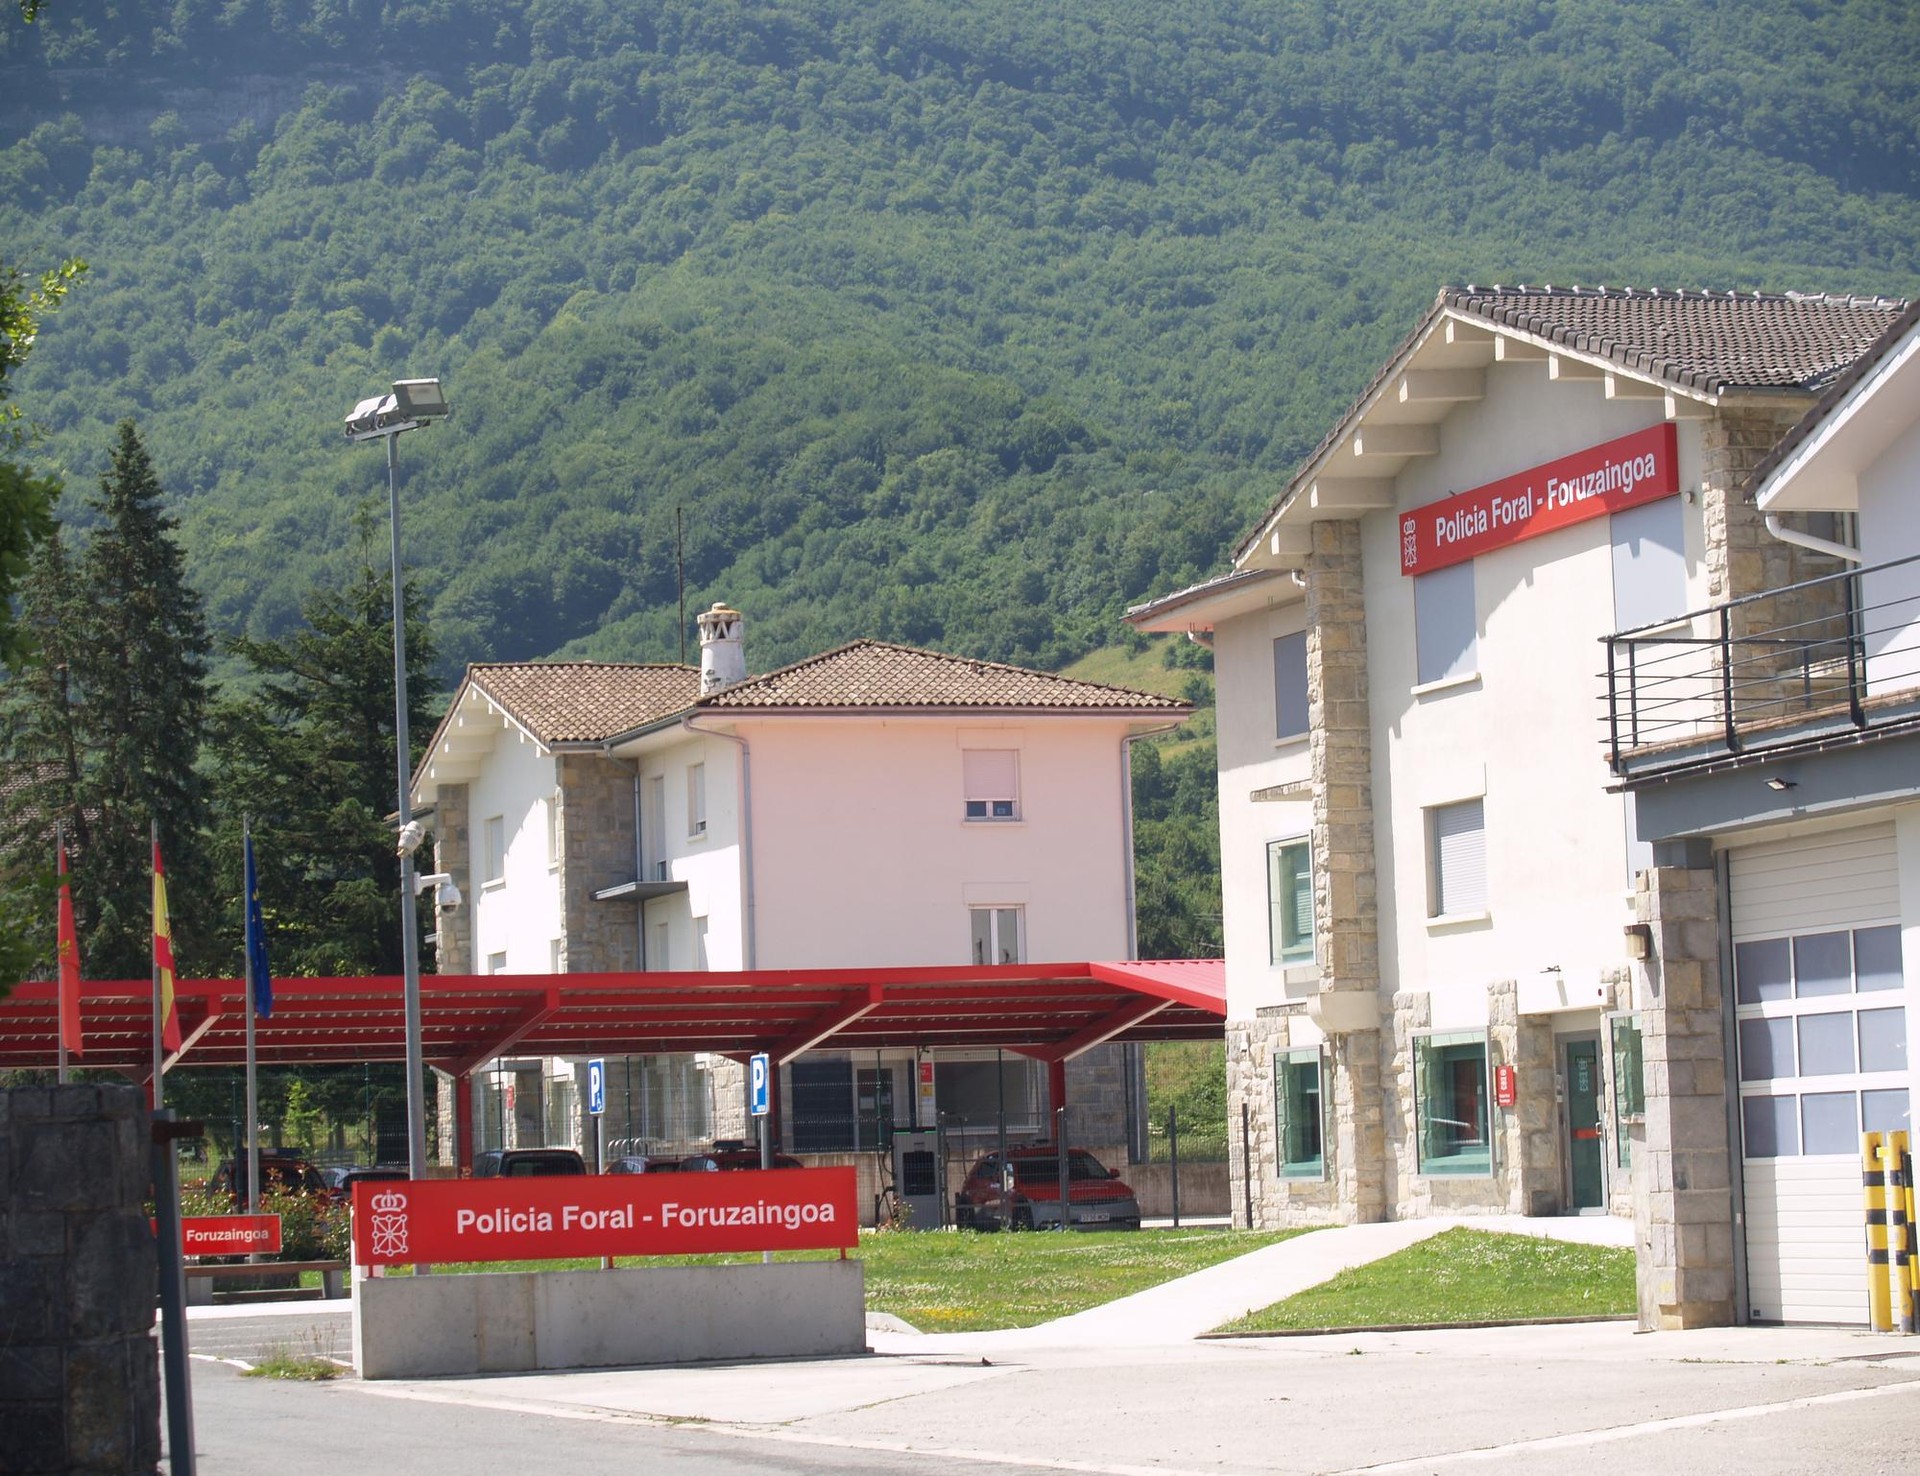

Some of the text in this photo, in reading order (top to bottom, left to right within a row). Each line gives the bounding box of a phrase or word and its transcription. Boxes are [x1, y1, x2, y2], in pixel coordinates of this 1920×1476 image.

[1435, 506, 1488, 547] Policia
[1491, 486, 1533, 529] Foral
[1547, 452, 1656, 511] Foruzaingoa
[590, 1066, 600, 1107] P
[752, 1060, 765, 1106] P
[186, 1228, 269, 1243] Foruzaingoa
[456, 1206, 553, 1235] Policia
[562, 1203, 634, 1231] Foral
[661, 1199, 835, 1230] Foruzaingoa
